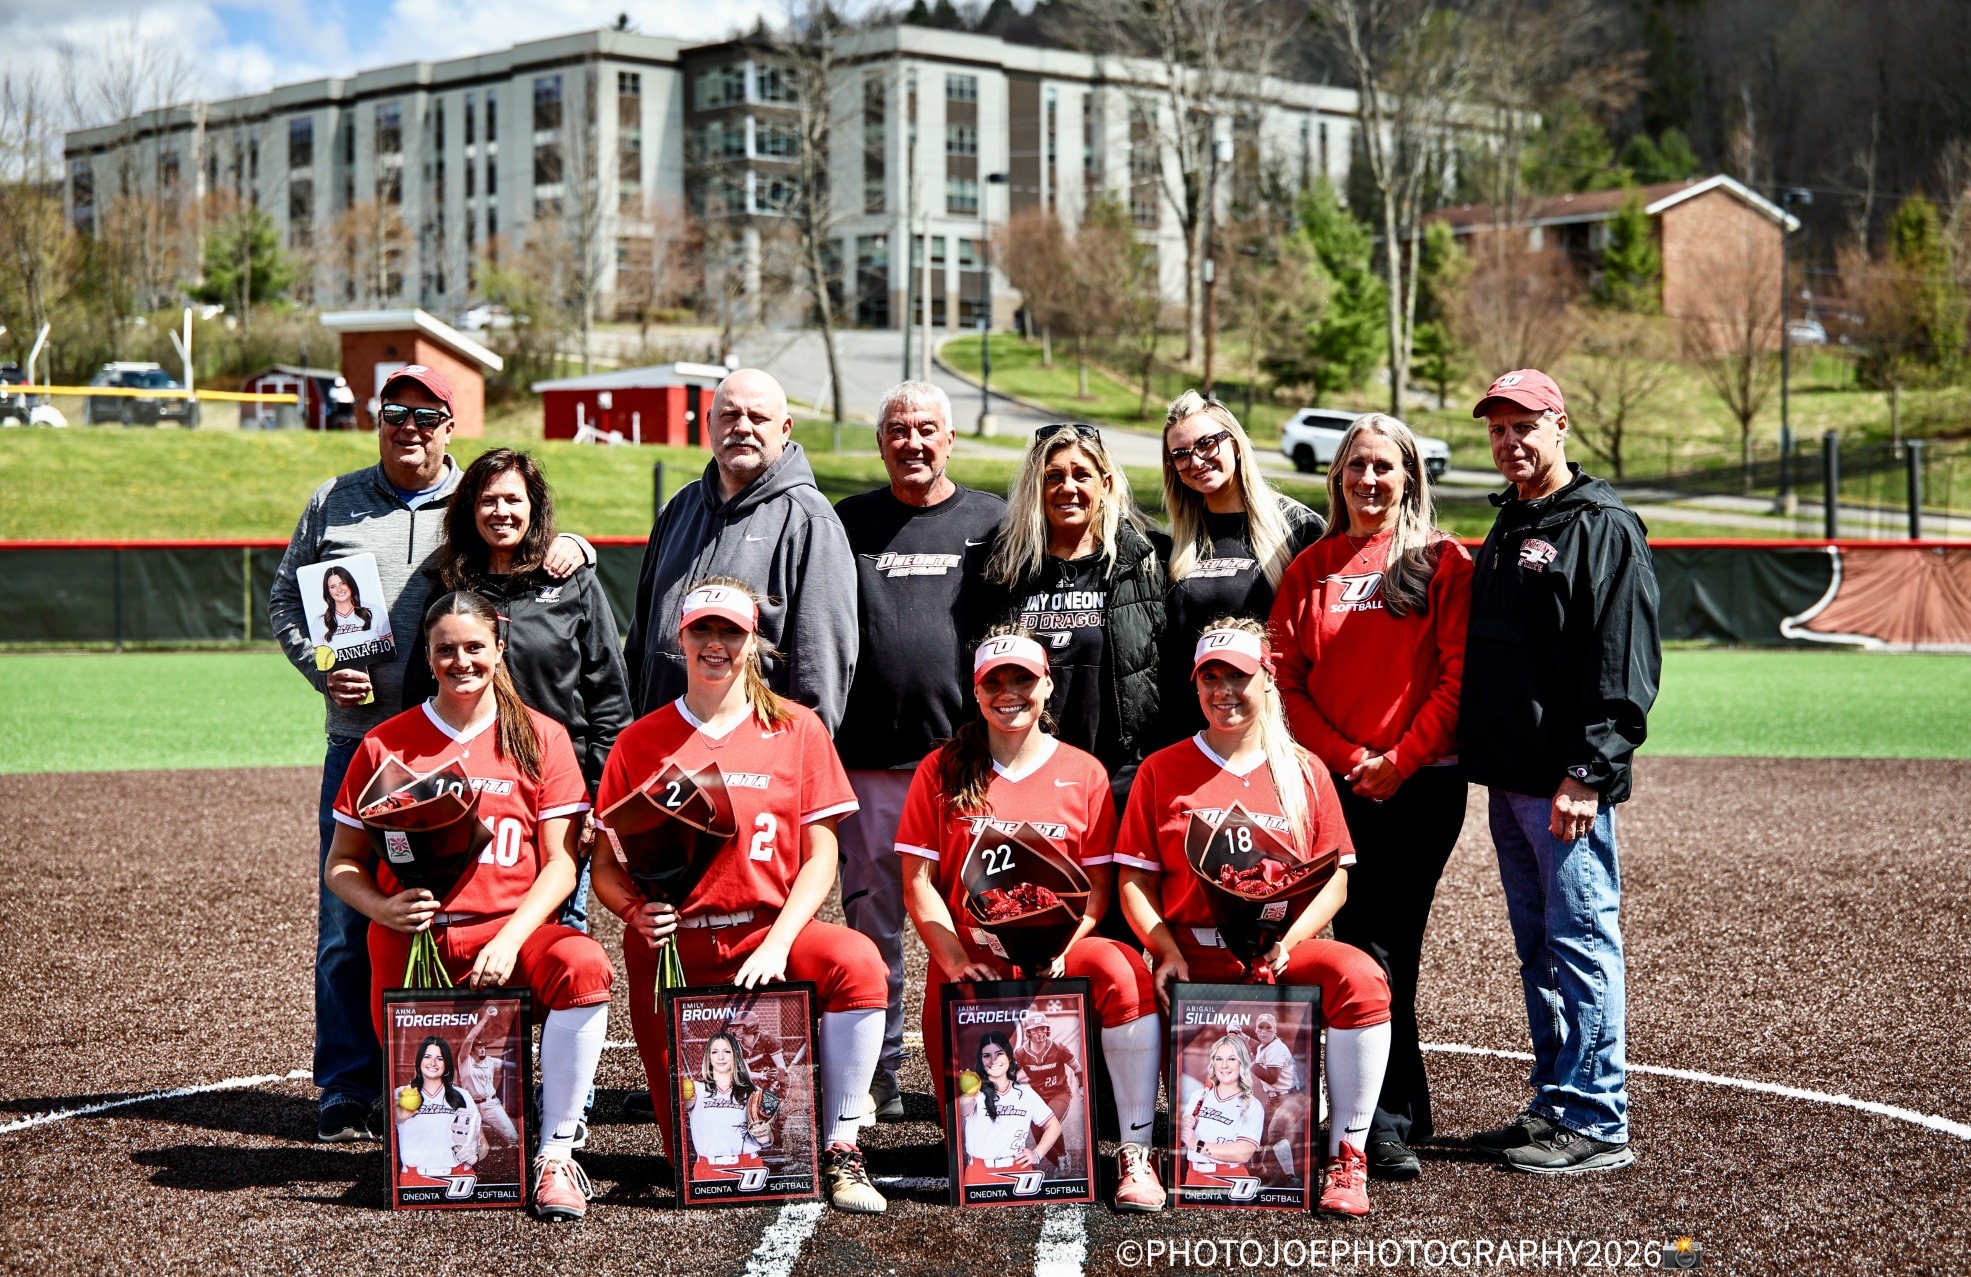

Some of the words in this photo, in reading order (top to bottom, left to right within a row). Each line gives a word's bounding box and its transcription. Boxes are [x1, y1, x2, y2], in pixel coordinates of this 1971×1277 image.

[868, 551, 961, 570] ONEONTA
[1517, 557, 1543, 573] STATE
[1051, 591, 1107, 610] ONEON
[1330, 600, 1383, 613] SOFTBALL
[1020, 614, 1038, 629] ED
[665, 781, 681, 807] 2
[749, 812, 777, 862] 2
[1224, 826, 1253, 854] 18
[981, 844, 1016, 876] 22
[395, 1013, 478, 1027] TORGERSEN
[682, 1007, 736, 1022] BROWN
[958, 1009, 1029, 1024] CARDELLO
[1185, 1013, 1251, 1026] SILLIMAN
[402, 1192, 440, 1200] ONEONTA
[477, 1190, 518, 1199] SOFTBALL
[694, 1185, 732, 1195] ONEONTA
[770, 1181, 811, 1191] SOFTBALL
[969, 1190, 1008, 1199] ONEONTA
[1045, 1185, 1086, 1195] SOFTBALL
[1185, 1191, 1223, 1200] ONEONTA
[1260, 1194, 1301, 1203] SOFTBALL
